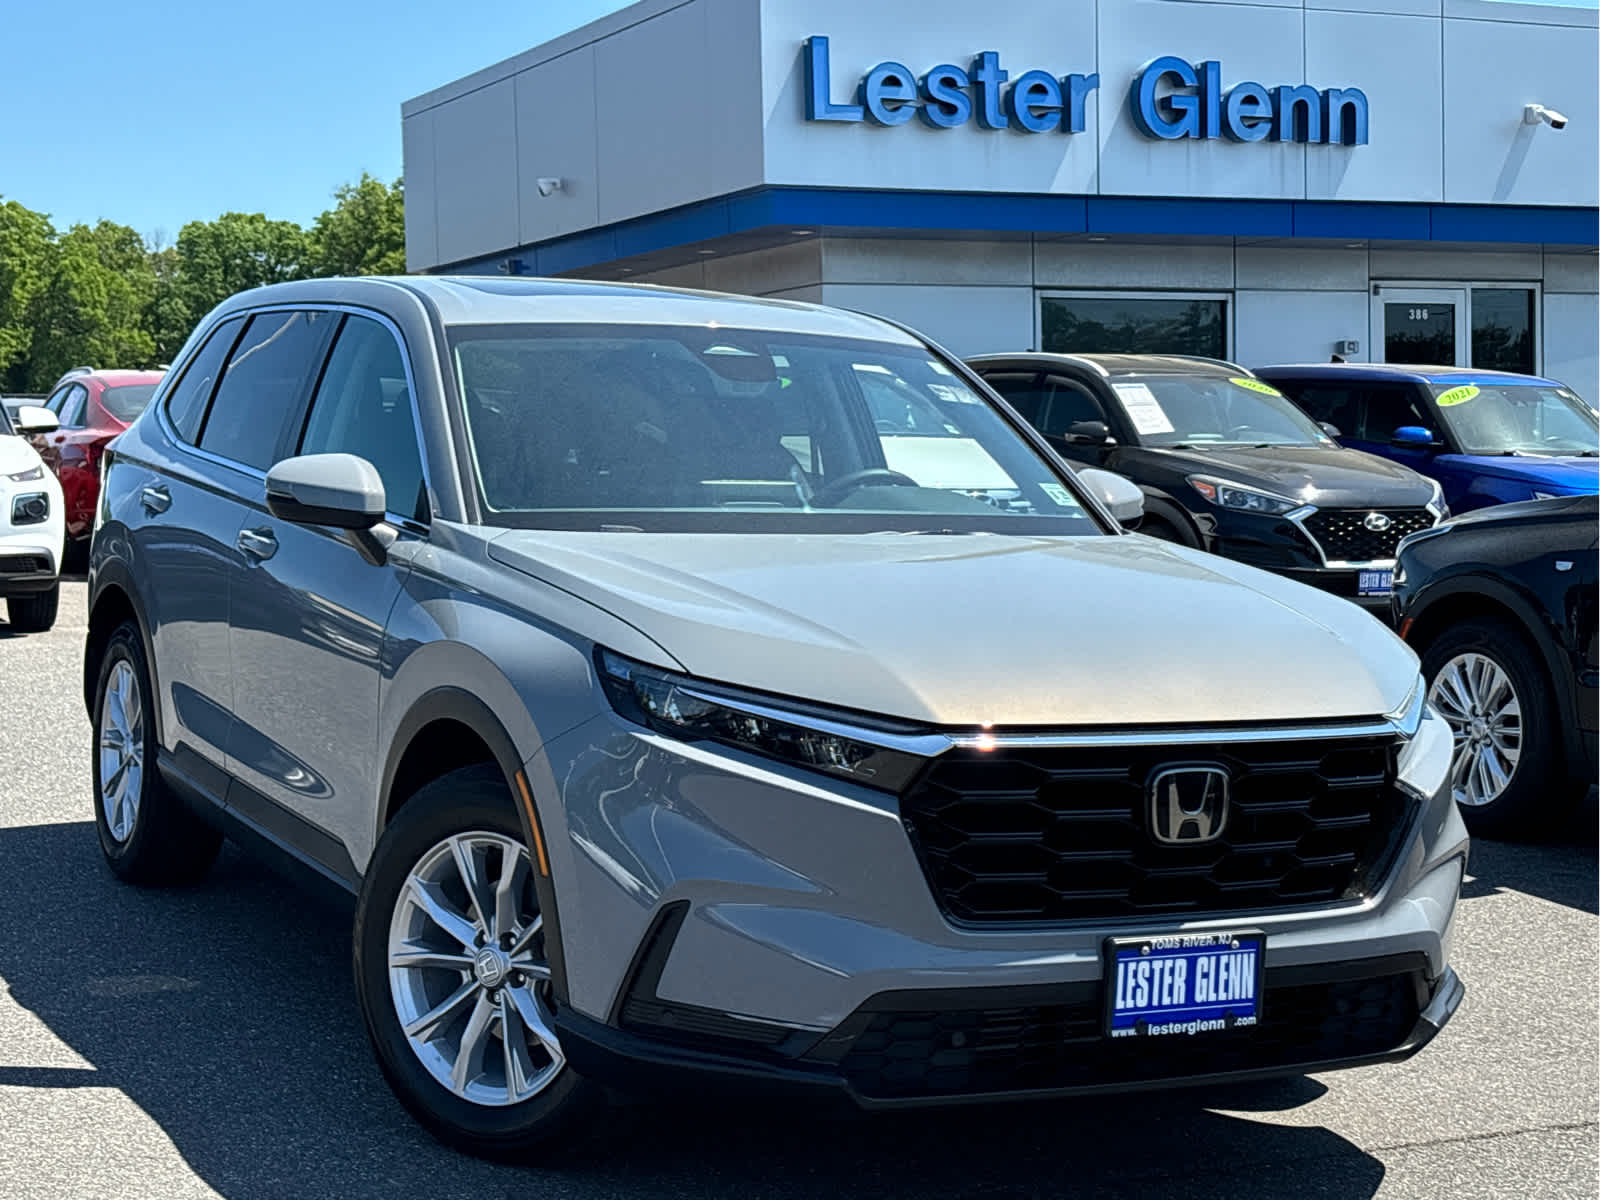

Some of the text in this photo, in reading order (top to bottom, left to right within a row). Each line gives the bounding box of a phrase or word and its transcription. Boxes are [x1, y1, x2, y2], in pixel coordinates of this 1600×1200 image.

[802, 35, 1369, 146] Lester Glenn
[1408, 308, 1429, 321] 386
[1444, 387, 1472, 404] 2021
[1151, 937, 1181, 950] TOMS
[1218, 932, 1233, 946] NJ
[1116, 952, 1256, 1010] LESTER GLENN
[1148, 1019, 1225, 1037] lesterglenn
